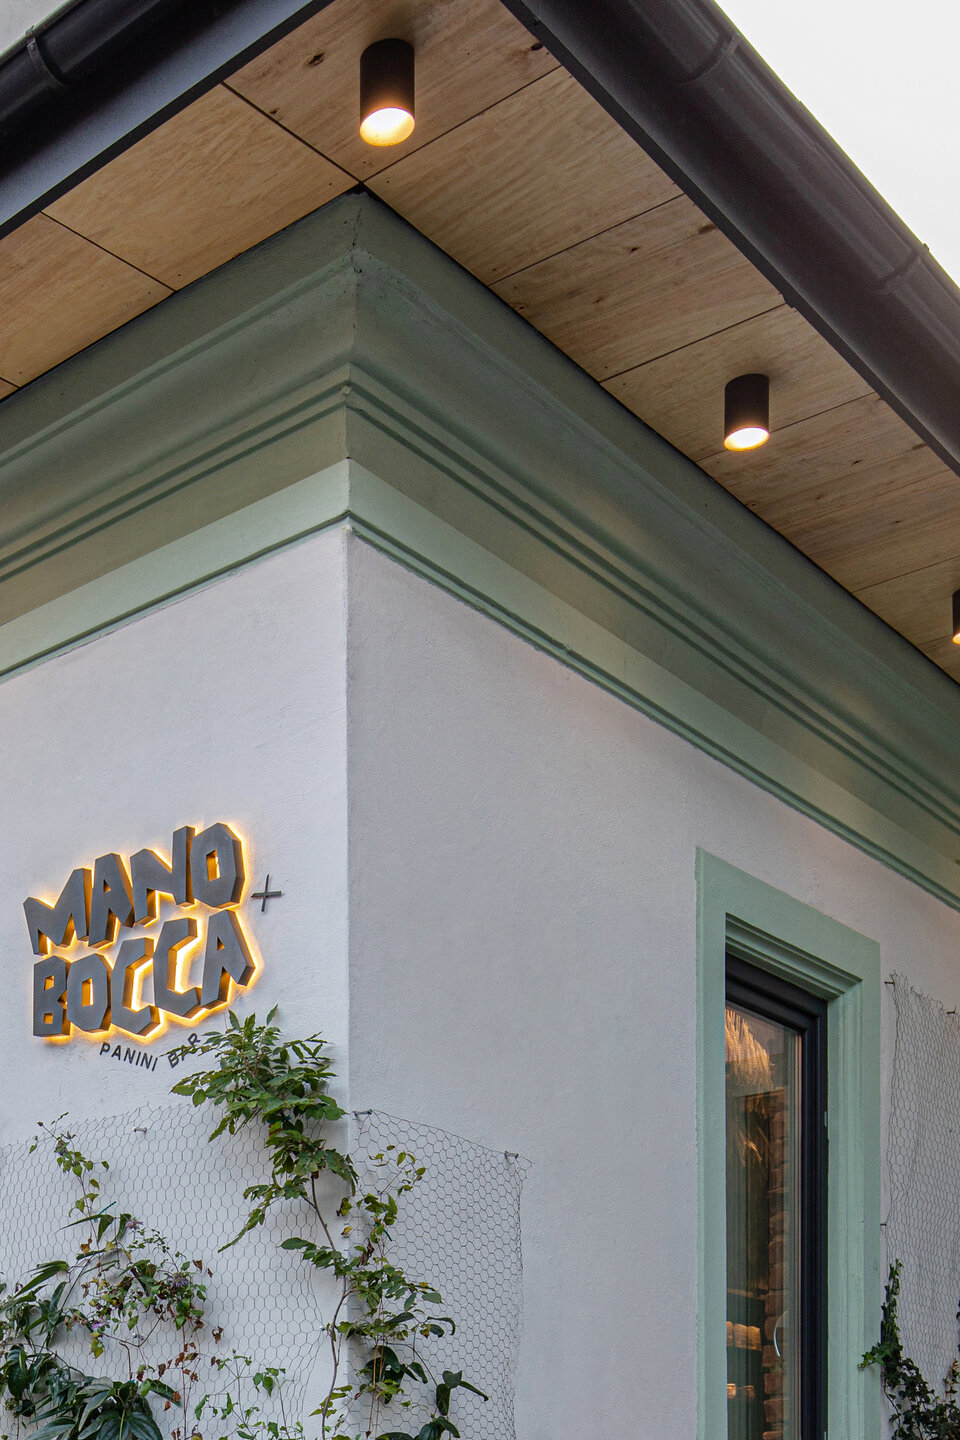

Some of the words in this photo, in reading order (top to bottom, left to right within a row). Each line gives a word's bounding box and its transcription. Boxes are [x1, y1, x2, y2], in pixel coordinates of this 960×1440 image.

[23, 822, 246, 956] MANO
[33, 909, 256, 1037] BOCCA
[100, 1042, 158, 1072] PANINI
[168, 1033, 201, 1068] BAR
